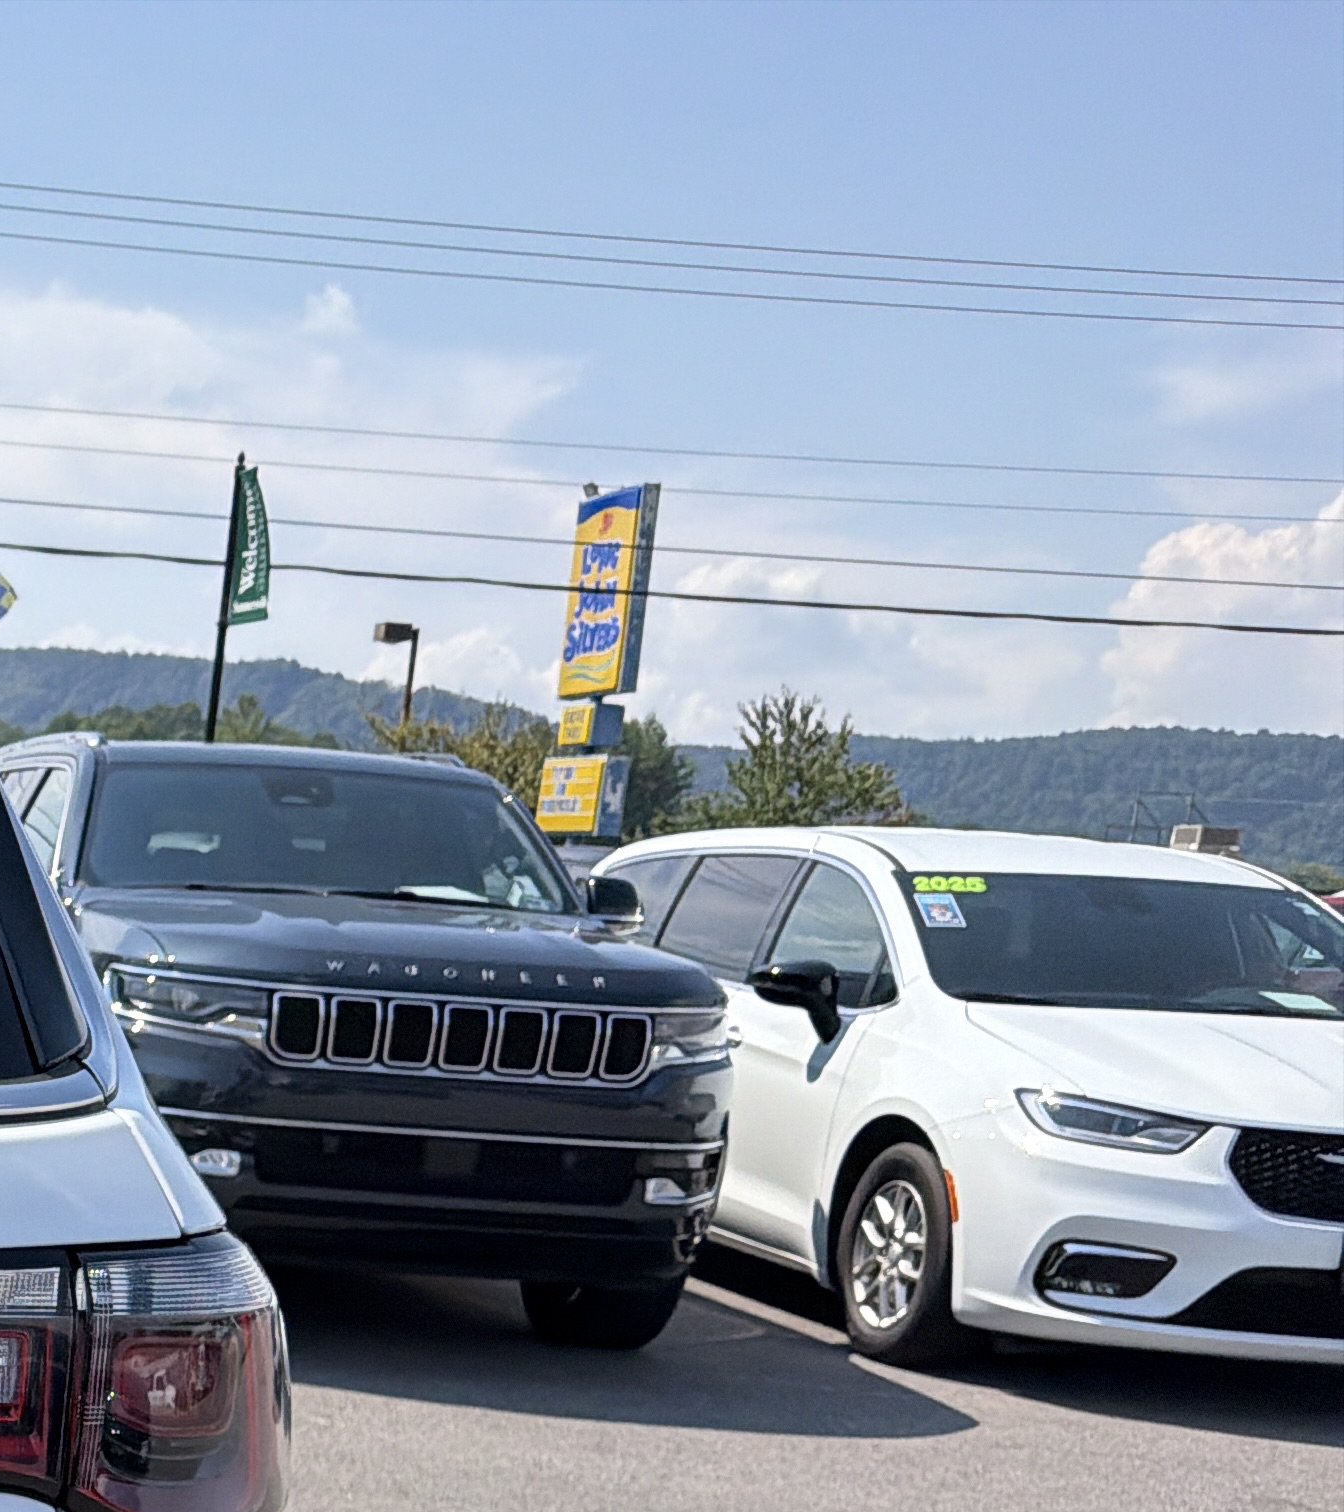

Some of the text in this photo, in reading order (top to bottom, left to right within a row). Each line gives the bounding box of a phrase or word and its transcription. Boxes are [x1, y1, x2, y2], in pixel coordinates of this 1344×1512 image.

[238, 481, 258, 595] Welcome
[912, 876, 987, 893] 2025
[326, 958, 607, 989] WAGONEER
